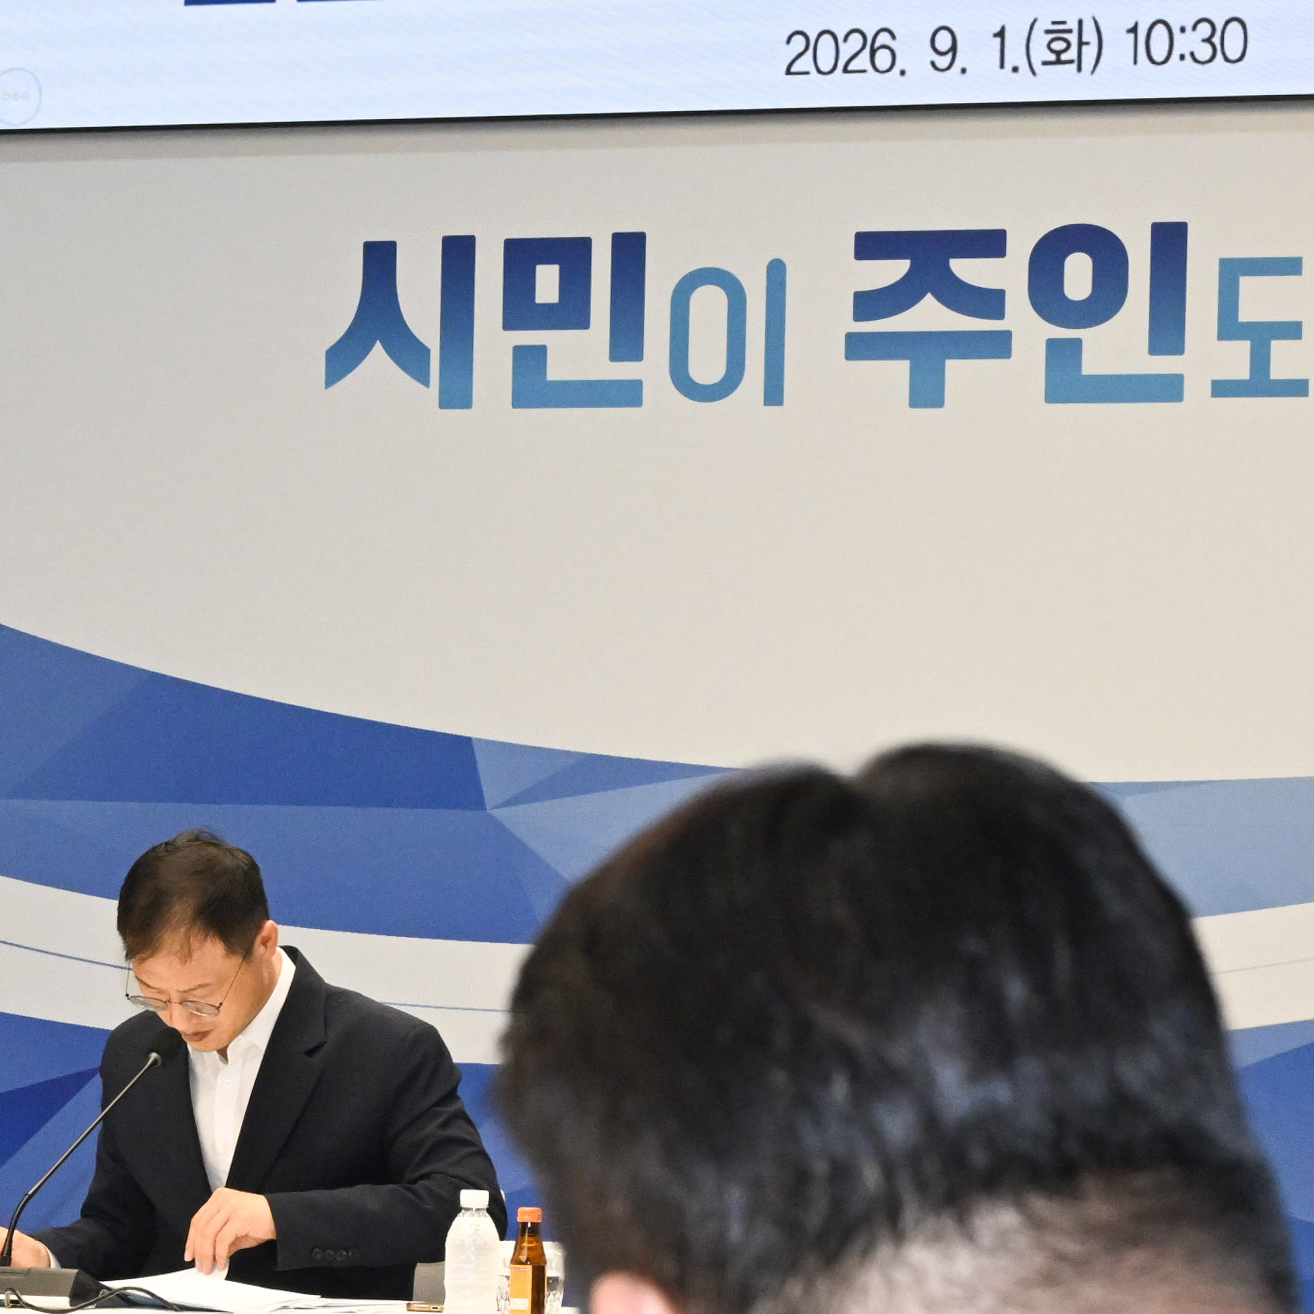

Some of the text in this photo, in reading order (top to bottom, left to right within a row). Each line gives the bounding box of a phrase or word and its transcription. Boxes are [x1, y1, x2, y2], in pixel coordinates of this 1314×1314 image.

[784, 15, 1249, 77] 2026. 9. 1.(화) 10:30
[325, 231, 787, 410] 시민이
